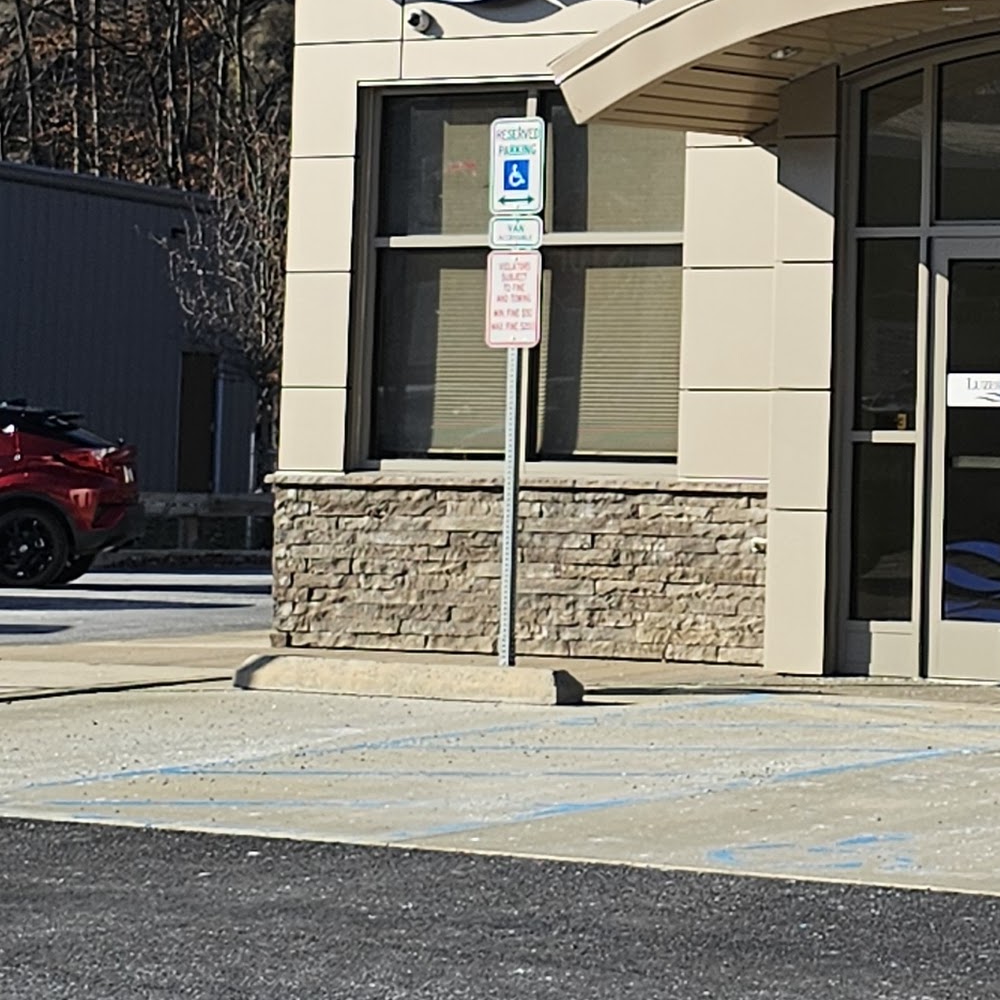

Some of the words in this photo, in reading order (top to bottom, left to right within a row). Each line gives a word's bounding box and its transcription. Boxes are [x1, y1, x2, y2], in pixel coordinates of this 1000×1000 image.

[497, 127, 540, 140] RESERVED
[499, 144, 537, 155] PARKING
[508, 225, 525, 233] VAN
